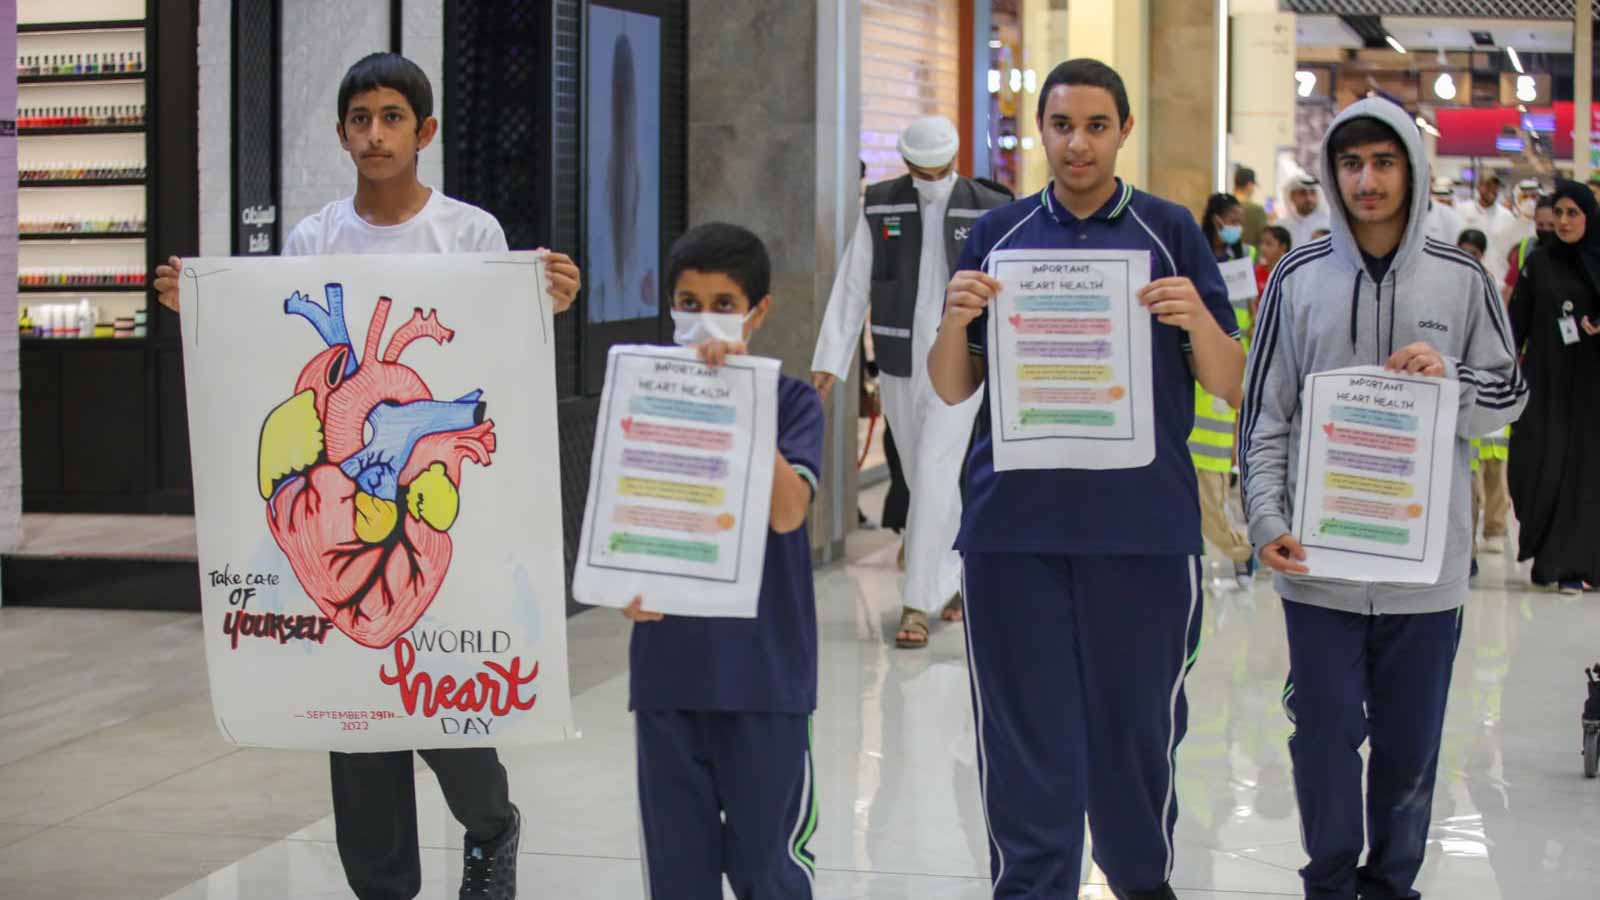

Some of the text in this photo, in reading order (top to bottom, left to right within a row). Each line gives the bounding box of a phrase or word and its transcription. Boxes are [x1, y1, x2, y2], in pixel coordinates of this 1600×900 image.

[1295, 71, 1317, 98] 7
[1434, 72, 1457, 100] 6
[1032, 263, 1090, 274] IMPORTANT
[1020, 279, 1104, 290] HEART HEALTH
[1418, 320, 1448, 332] adidas
[654, 361, 720, 378] IMPORTANT
[638, 378, 731, 398] HEART HEALTH
[1349, 377, 1405, 392] IMPORTANT
[1336, 392, 1415, 410] HEART HEALTH
[208, 563, 281, 587] Take care
[229, 587, 257, 610] OF
[411, 629, 512, 655] WORLD
[379, 637, 539, 718] heart
[306, 710, 369, 720] SEPTEMBER
[340, 721, 369, 731] 2022
[440, 716, 495, 737] DAY
